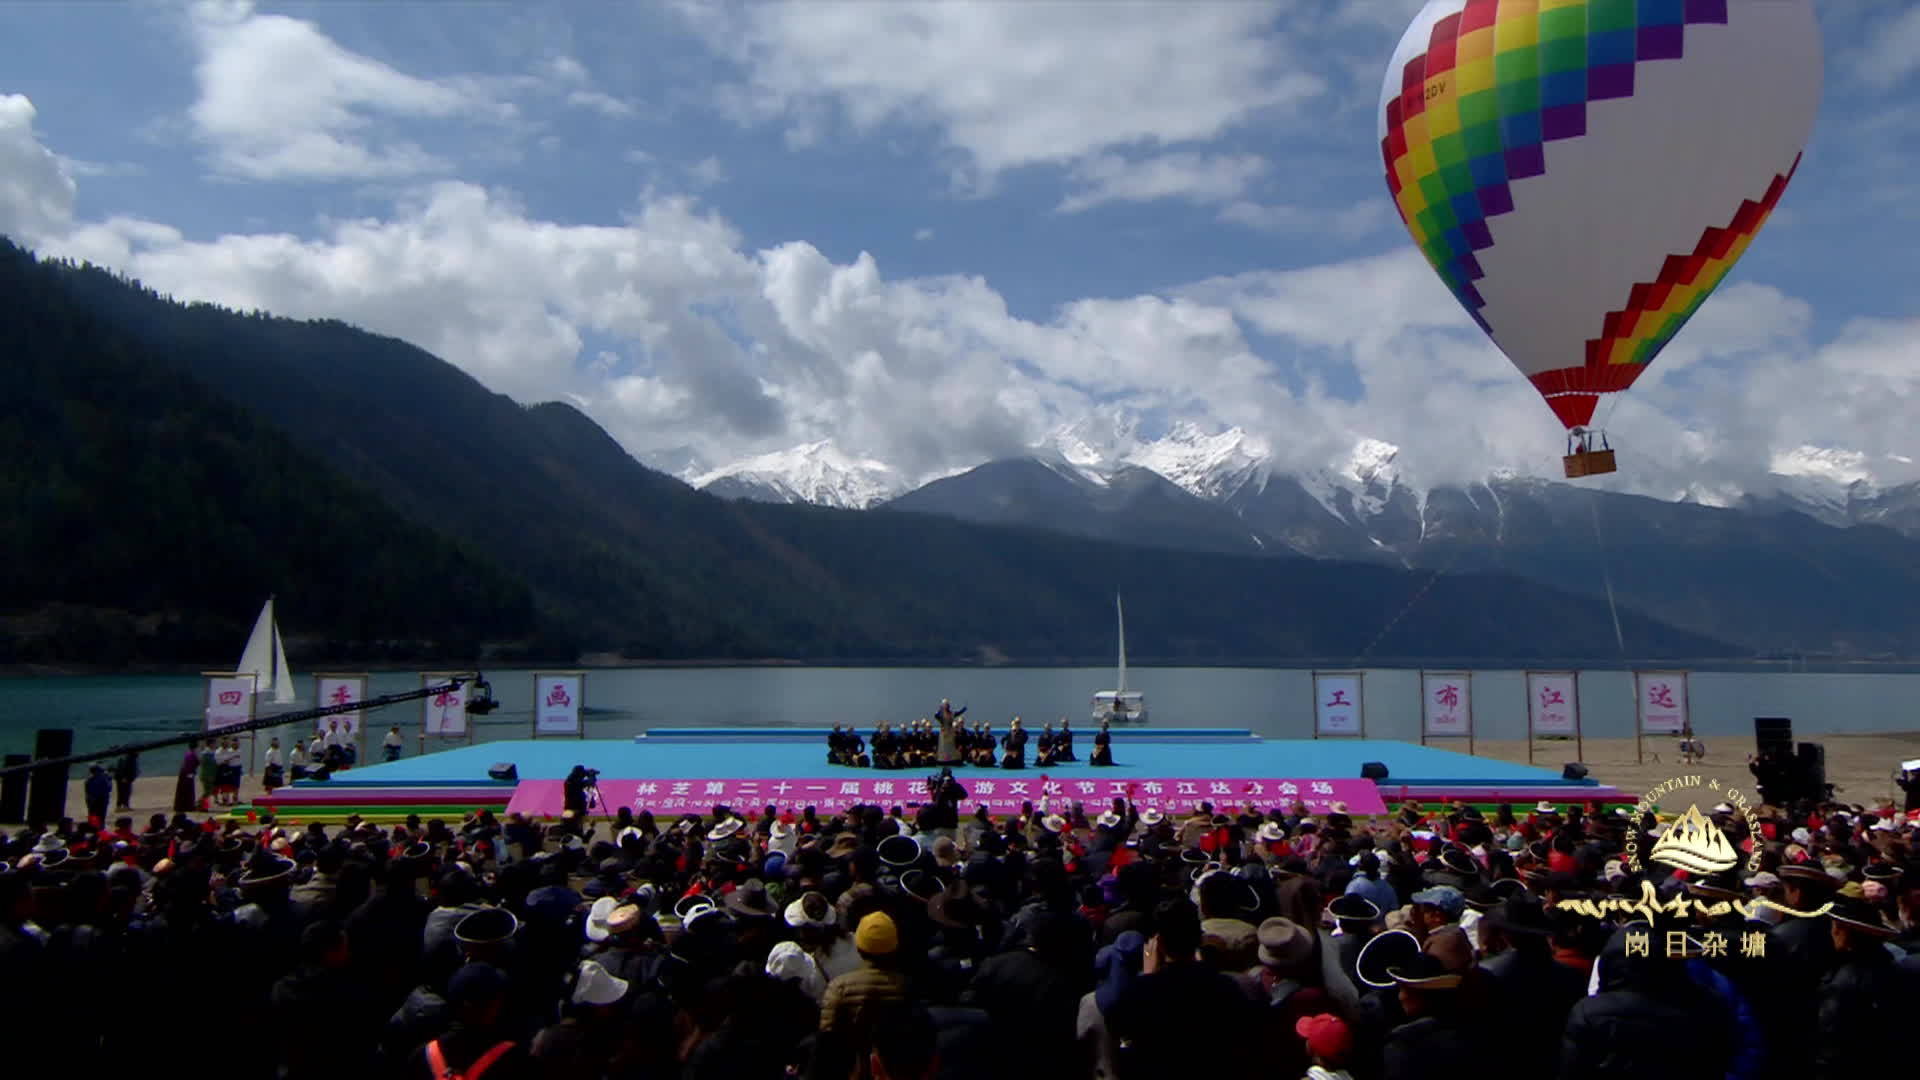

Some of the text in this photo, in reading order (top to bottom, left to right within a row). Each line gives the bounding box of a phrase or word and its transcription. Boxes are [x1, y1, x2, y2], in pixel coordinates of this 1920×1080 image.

[1326, 689, 1352, 708] 工
[1434, 684, 1459, 712] 布
[1539, 686, 1566, 709] 江
[1648, 684, 1679, 709] 达
[636, 780, 1335, 796] 林芝第二十一届桃花游文化节工布江达分会场
